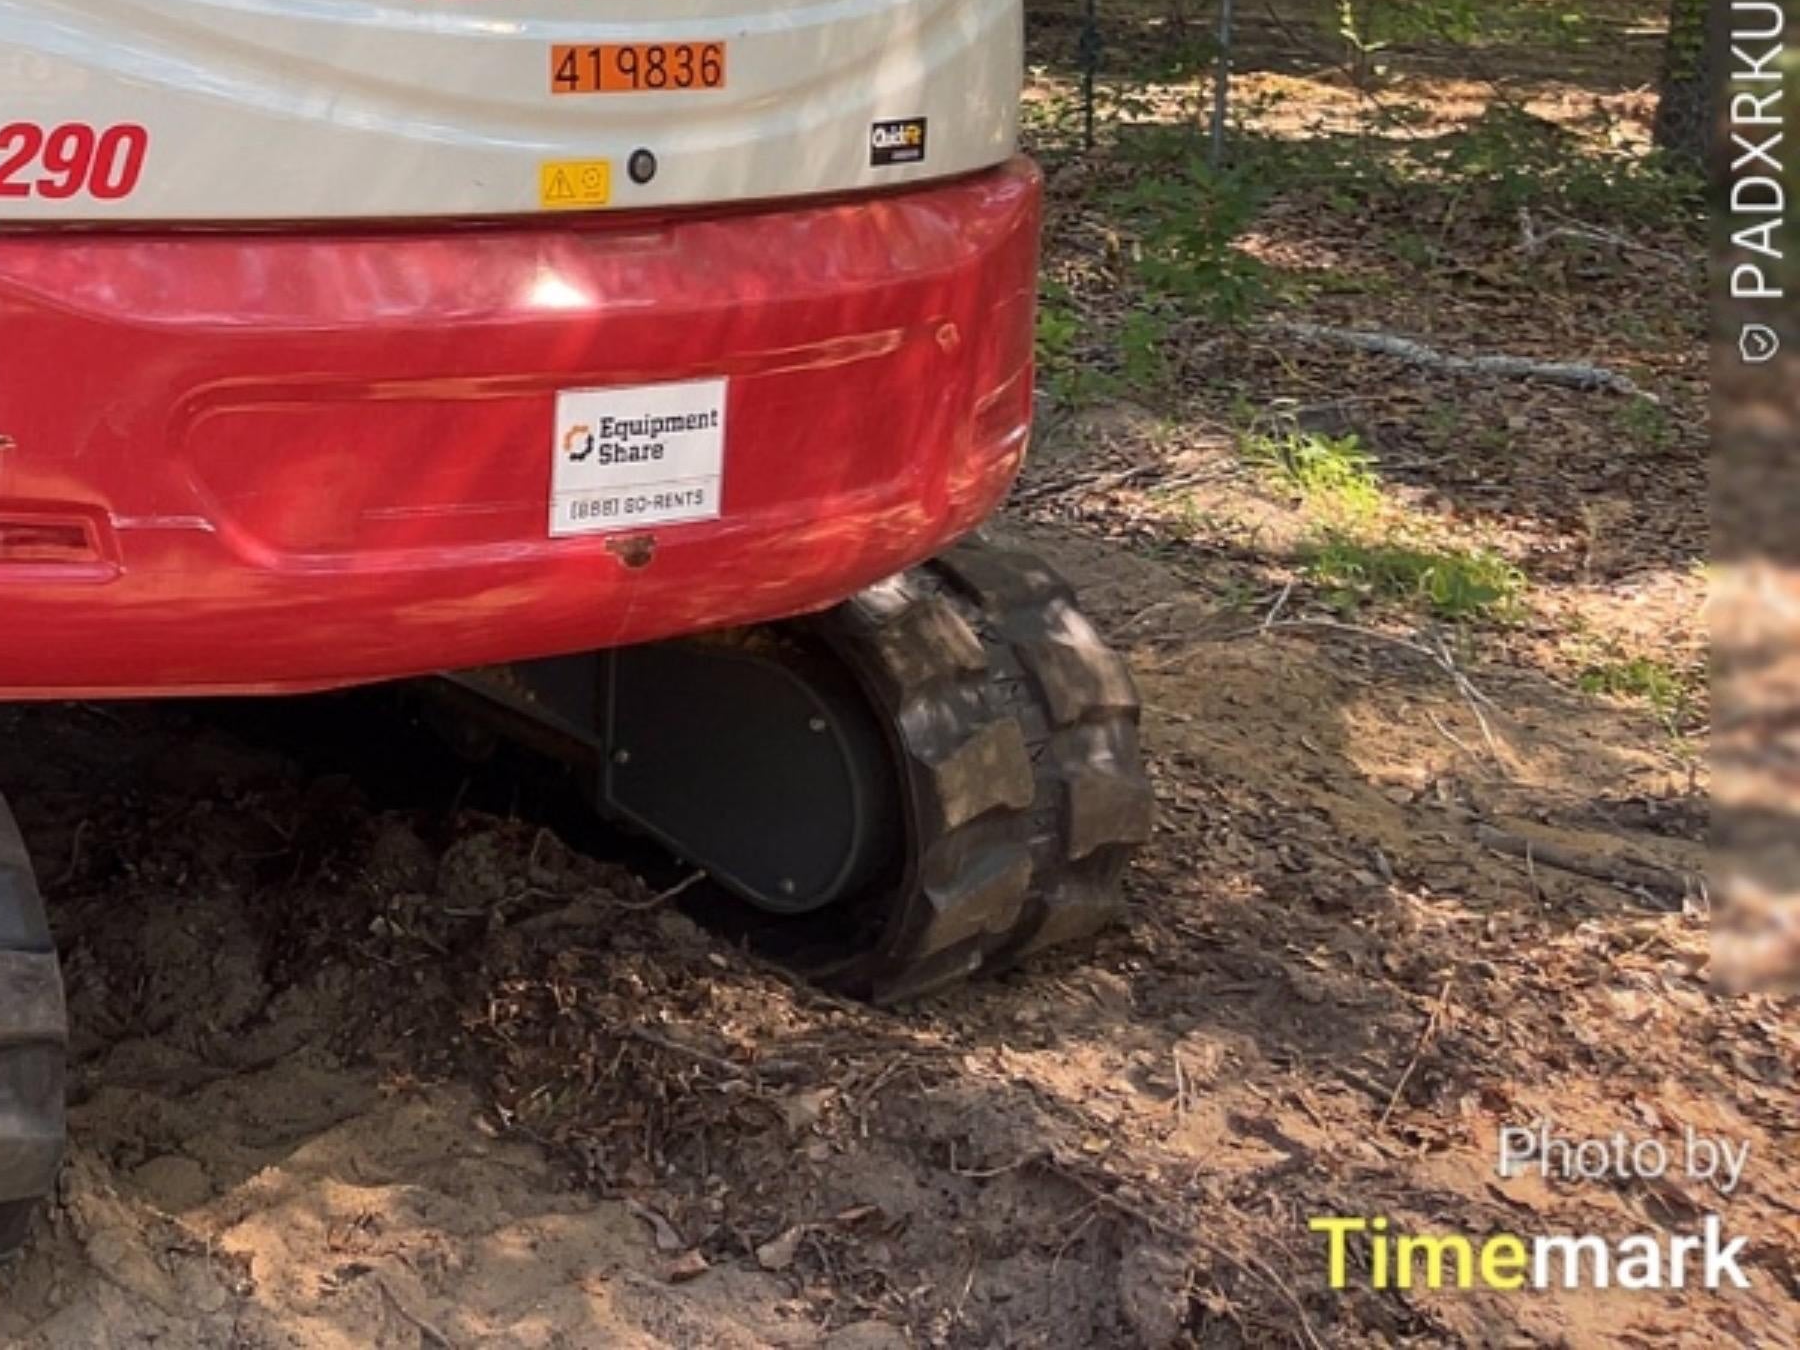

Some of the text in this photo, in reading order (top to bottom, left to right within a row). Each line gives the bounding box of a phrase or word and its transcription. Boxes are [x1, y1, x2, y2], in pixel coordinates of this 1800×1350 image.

[554, 44, 722, 91] 419836
[599, 409, 718, 441] Equipment
[599, 442, 665, 465] Share
